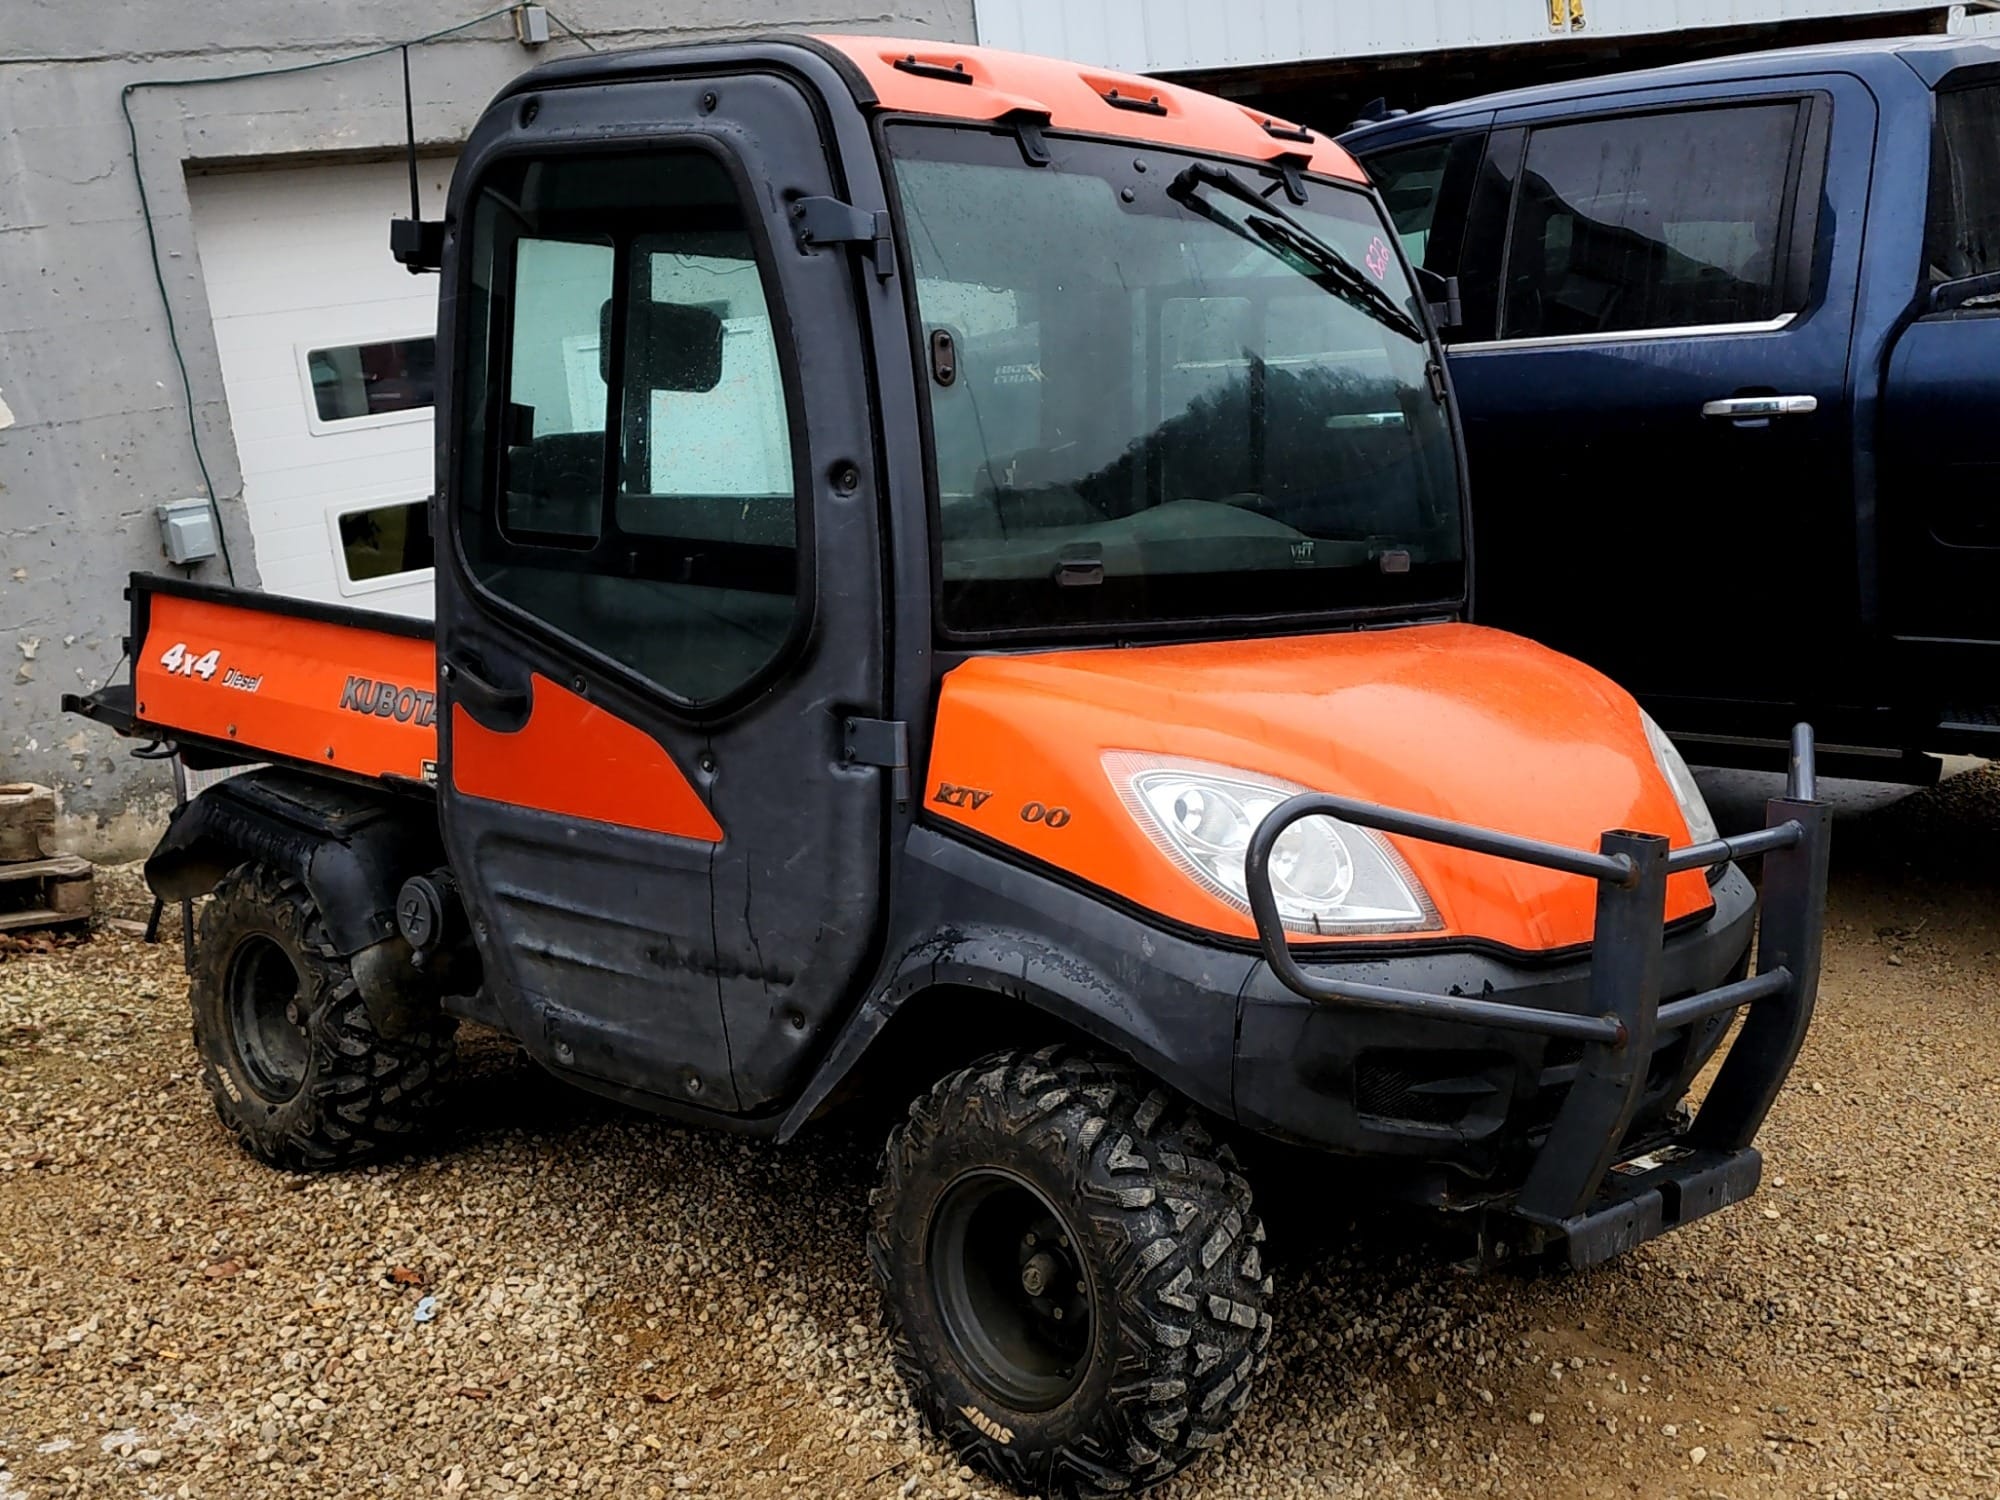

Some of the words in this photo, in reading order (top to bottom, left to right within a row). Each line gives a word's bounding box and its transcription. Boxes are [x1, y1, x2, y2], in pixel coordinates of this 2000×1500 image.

[160, 643, 221, 681] 4x4
[222, 668, 263, 693] Diesel
[933, 783, 993, 810] RTV
[955, 1404, 1016, 1445] SUNF
